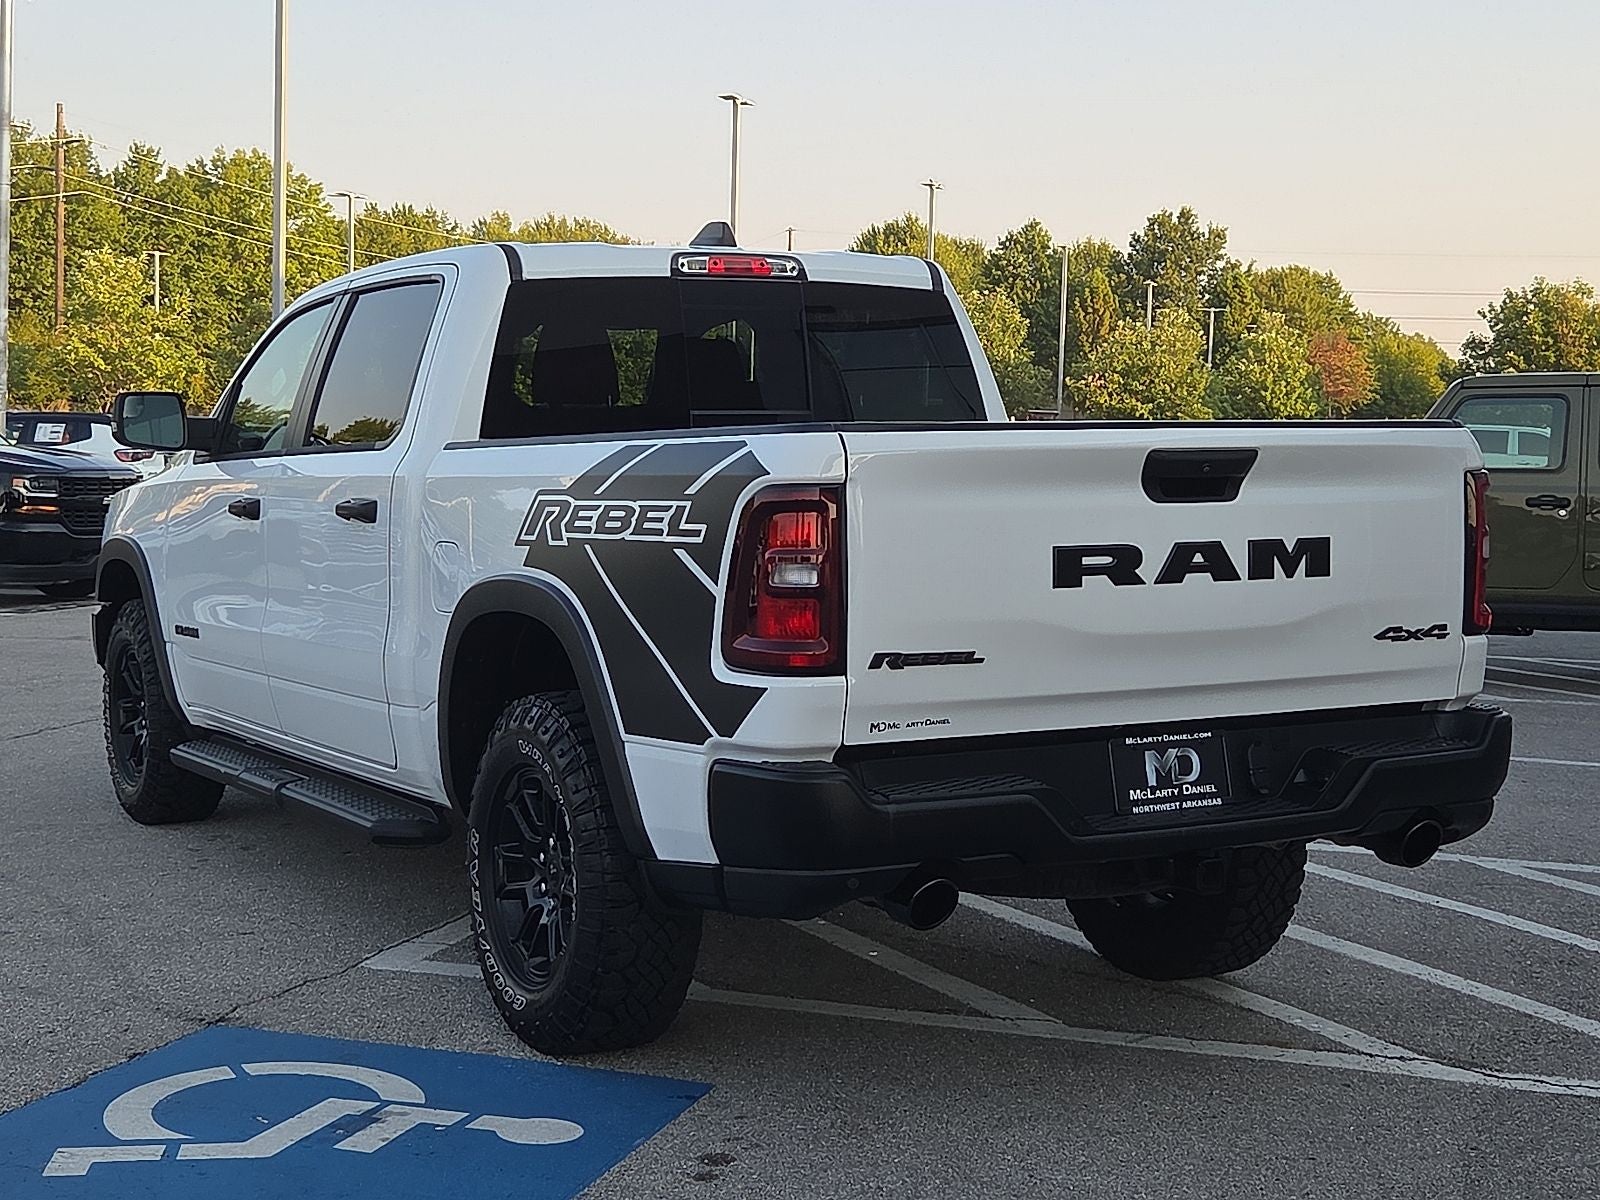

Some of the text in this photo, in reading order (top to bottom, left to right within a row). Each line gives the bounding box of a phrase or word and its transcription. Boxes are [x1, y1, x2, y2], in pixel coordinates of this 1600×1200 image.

[518, 494, 708, 546] REBEL
[1052, 536, 1331, 589] RAM
[1373, 623, 1451, 643] 4x4
[867, 650, 986, 671] REBEL
[1144, 747, 1201, 787] MD
[1182, 784, 1218, 795] DANIEL
[1132, 797, 1223, 814] NORTHWEST ARKANSAS
[468, 828, 527, 1012] GOODYEAR
